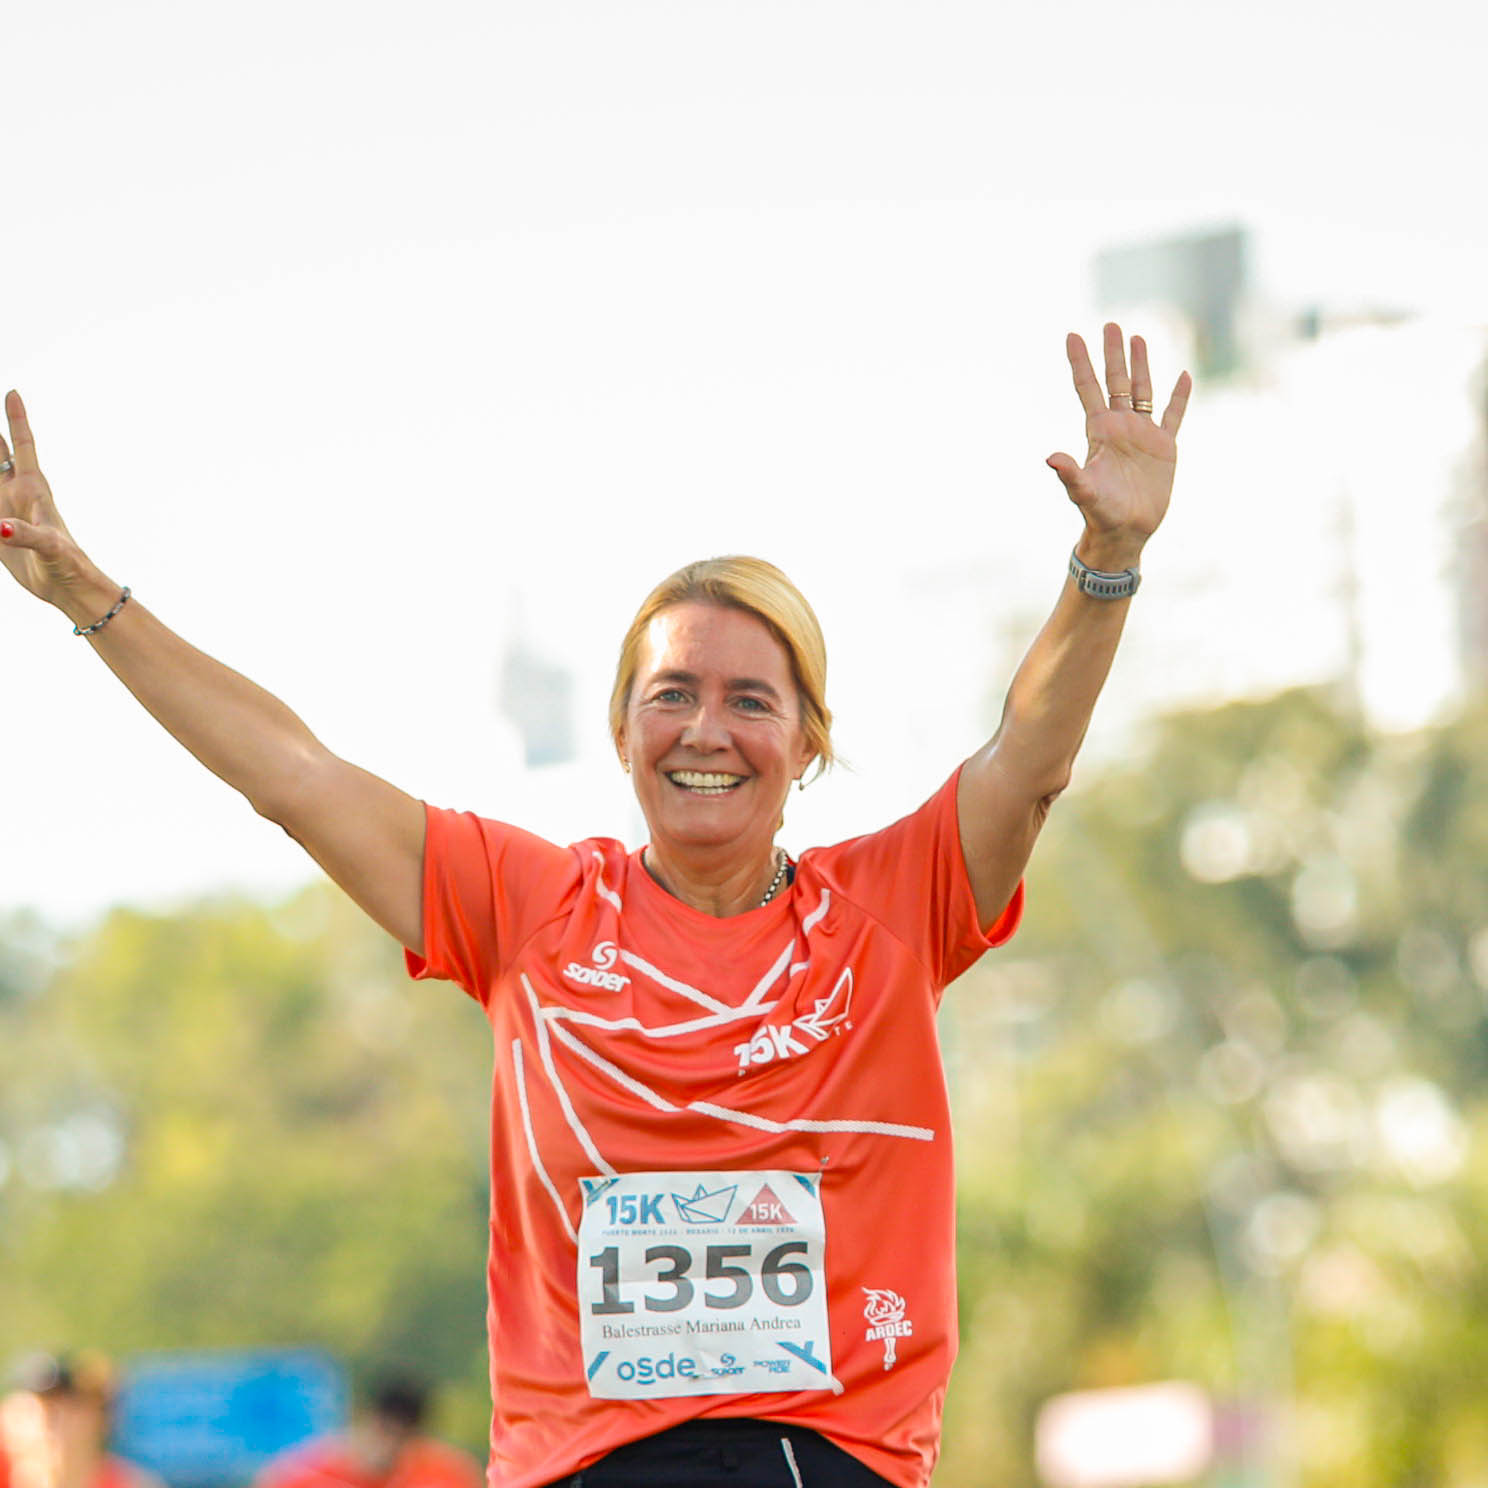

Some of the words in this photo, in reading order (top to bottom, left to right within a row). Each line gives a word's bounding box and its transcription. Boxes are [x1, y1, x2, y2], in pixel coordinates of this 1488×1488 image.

[734, 1024, 810, 1067] 15K
[606, 1193, 666, 1225] 15K
[751, 1203, 784, 1220] 15K
[589, 1241, 813, 1315] 1356
[602, 1322, 682, 1339] Balestrasse
[686, 1319, 745, 1335] Mariana
[750, 1316, 801, 1331] Andrea
[865, 1320, 913, 1341] ARDEC
[617, 1352, 696, 1384] osde
